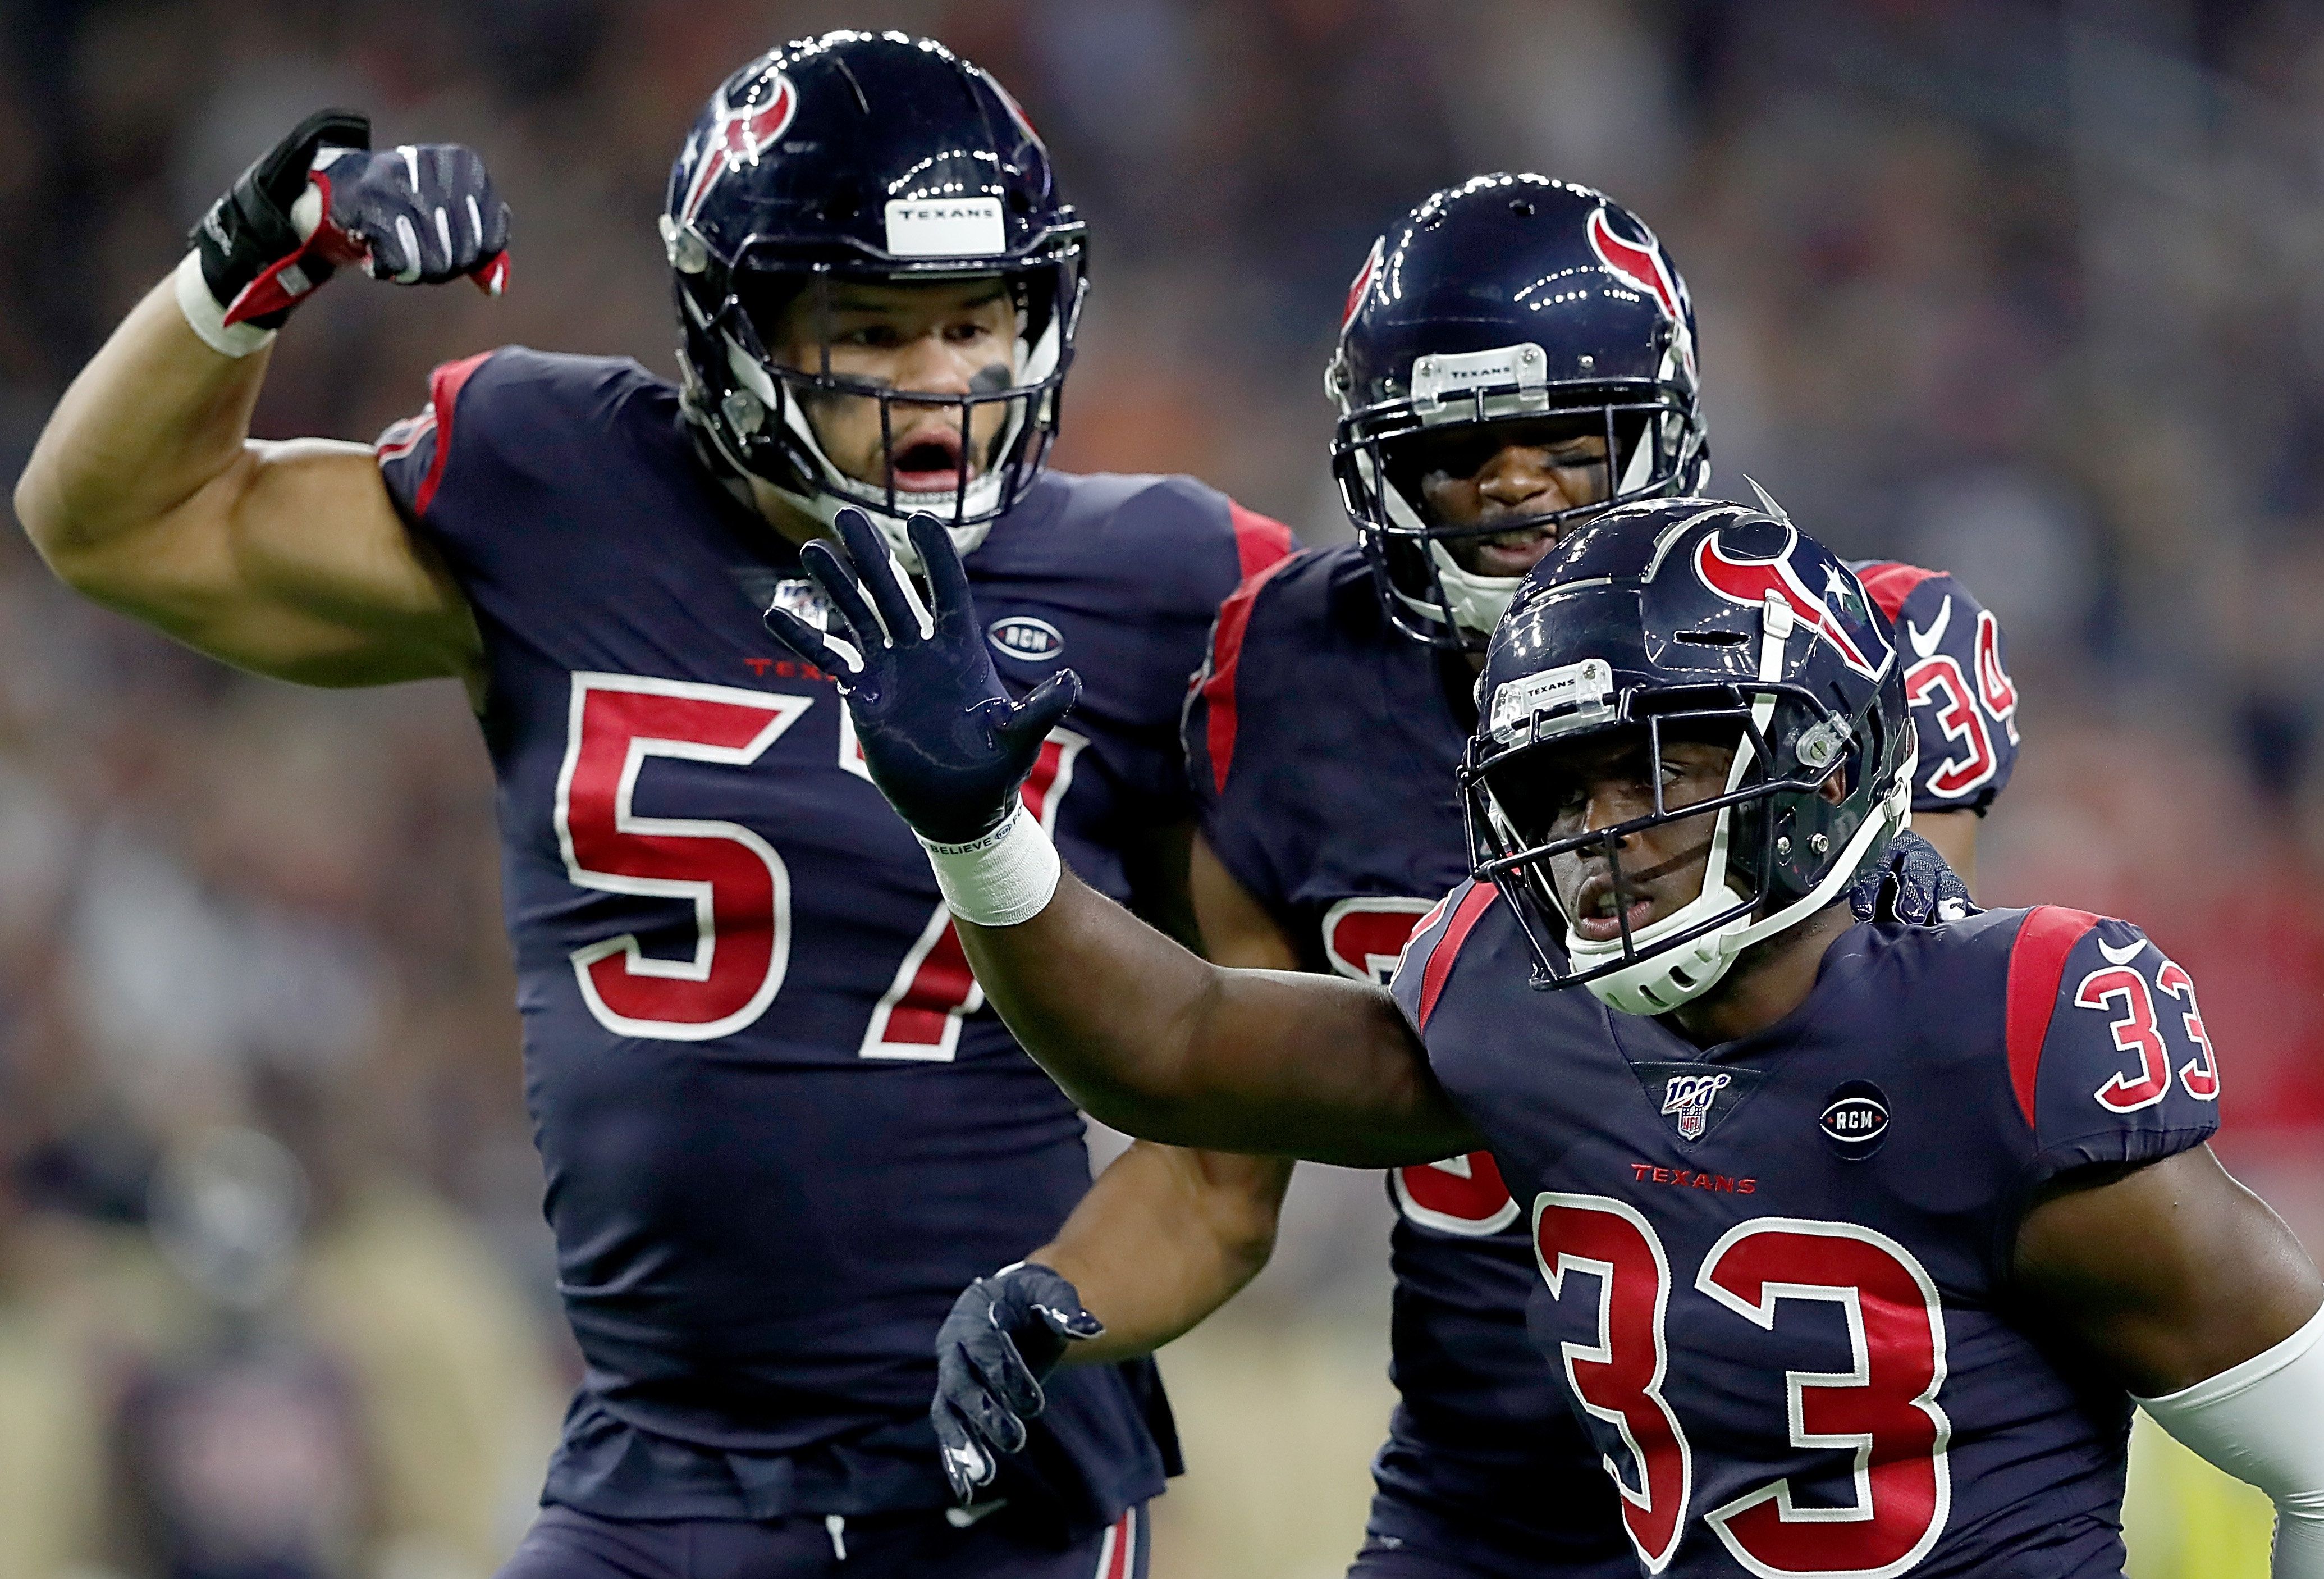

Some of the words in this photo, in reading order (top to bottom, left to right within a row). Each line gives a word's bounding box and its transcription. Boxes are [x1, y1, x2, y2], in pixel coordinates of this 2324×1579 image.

[898, 209, 993, 220] TEXANS
[1451, 367, 1510, 379] TEXANS
[743, 658, 836, 682] TEX
[1527, 678, 1575, 697] TEXANS
[930, 837, 992, 855] BELIEVE
[2074, 960, 2220, 1113] 33
[1836, 1110, 1873, 1129] RCM
[1631, 1163, 1758, 1194] TEXANS
[1532, 1192, 1951, 1579] 33
